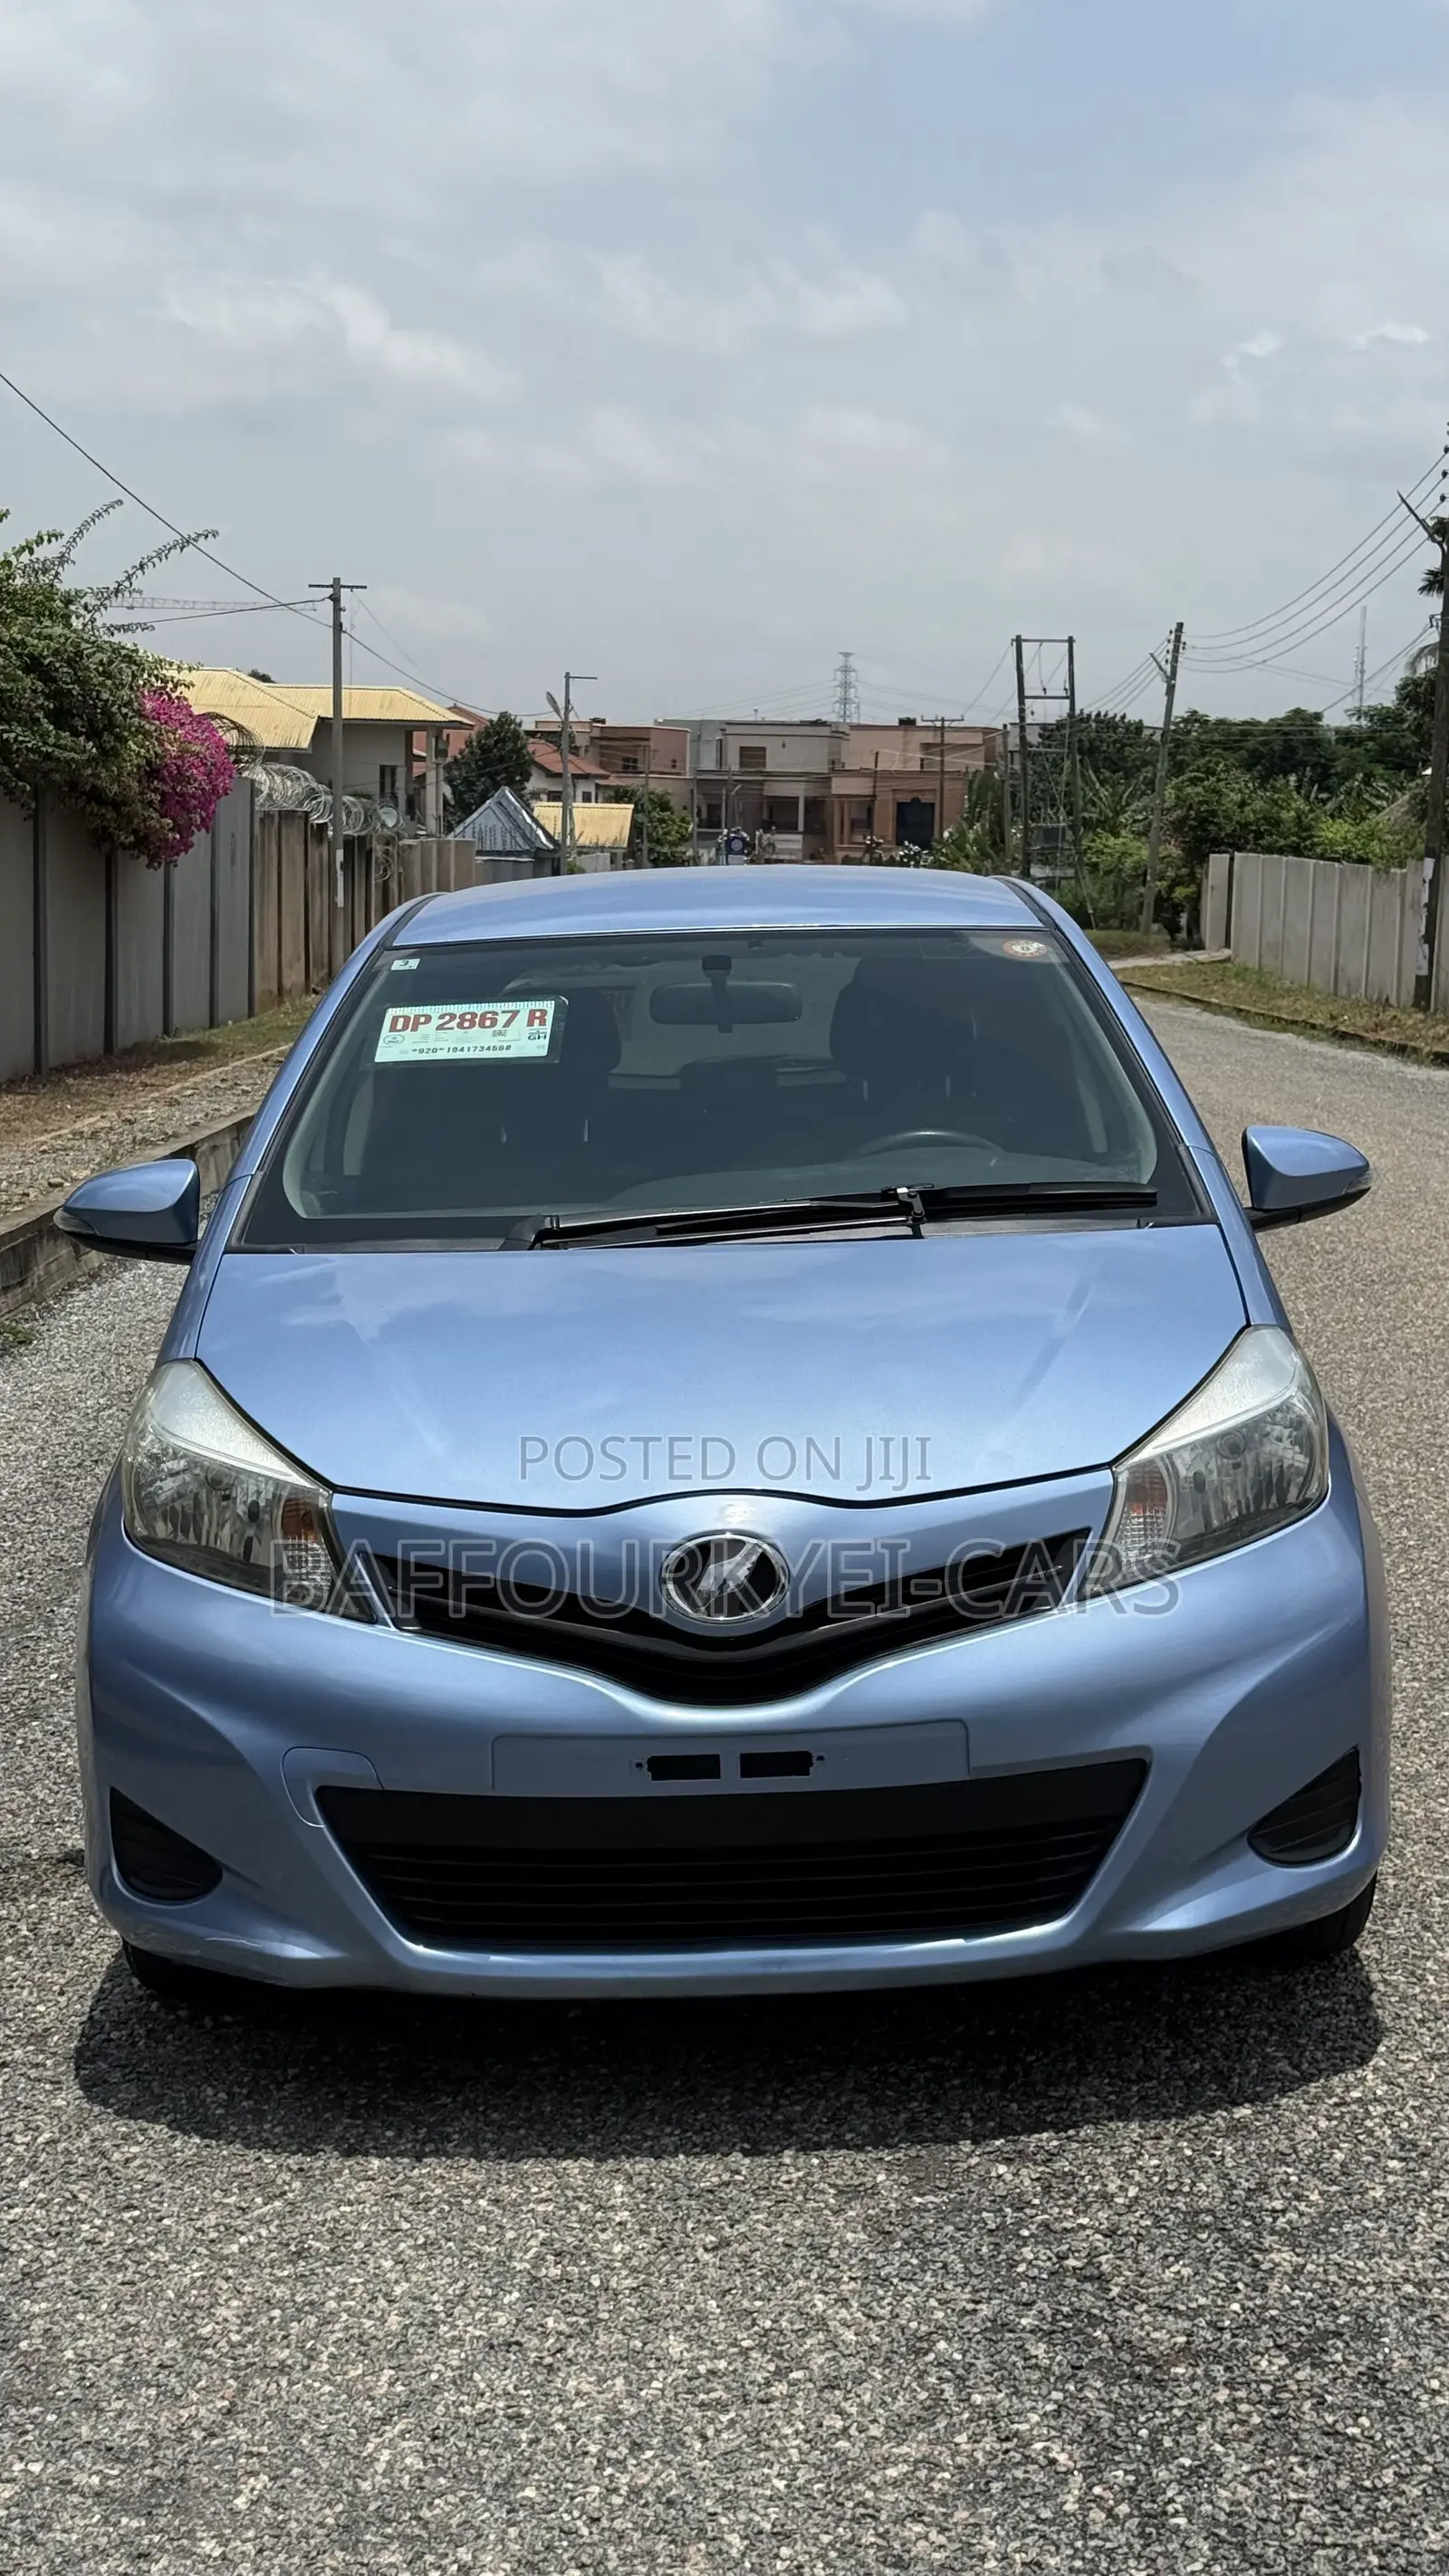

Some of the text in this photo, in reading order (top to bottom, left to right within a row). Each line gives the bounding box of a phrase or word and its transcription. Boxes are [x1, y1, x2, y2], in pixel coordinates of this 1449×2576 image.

[389, 1008, 548, 1032] DP 2867 R
